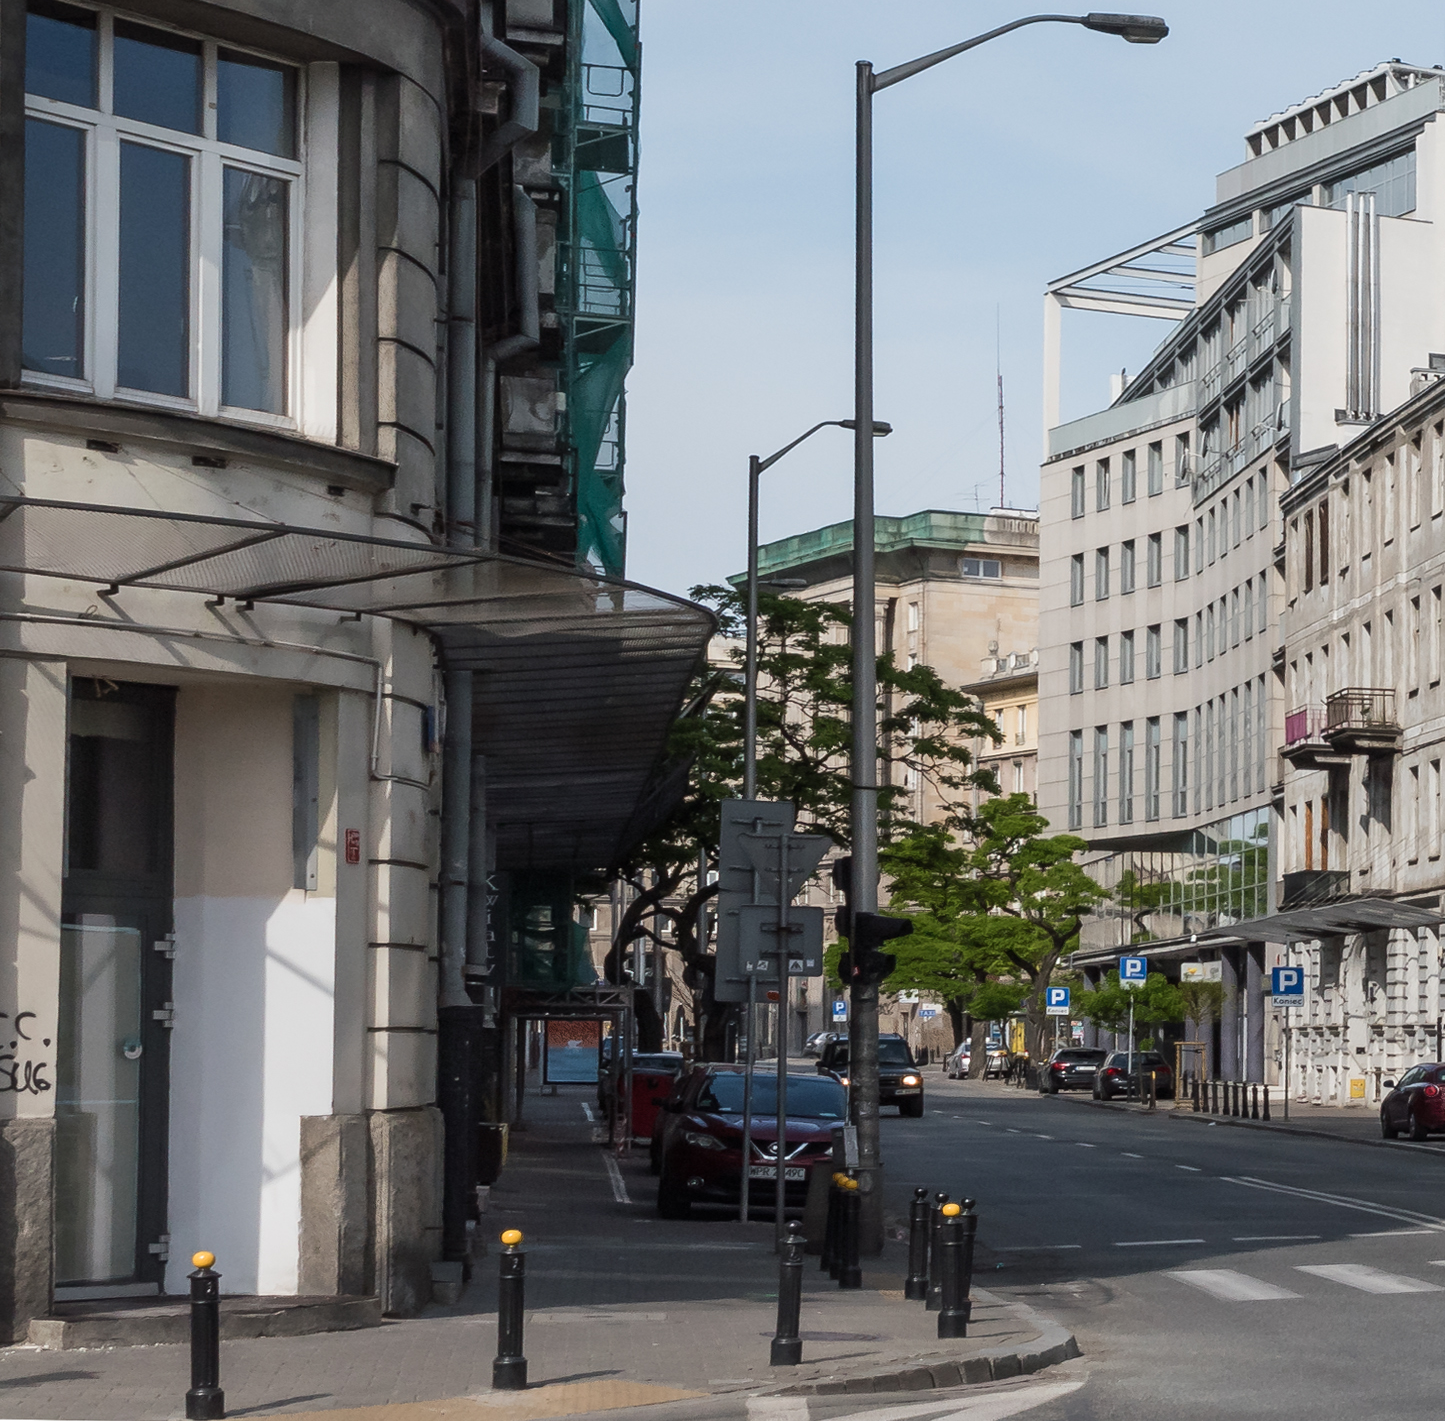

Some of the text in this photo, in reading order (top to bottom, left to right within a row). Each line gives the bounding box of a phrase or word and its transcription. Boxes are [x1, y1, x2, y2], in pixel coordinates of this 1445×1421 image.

[1126, 959, 1142, 977] P
[1279, 970, 1298, 992] P
[1051, 989, 1066, 1005] P
[750, 1166, 804, 1178] WPR 249C
